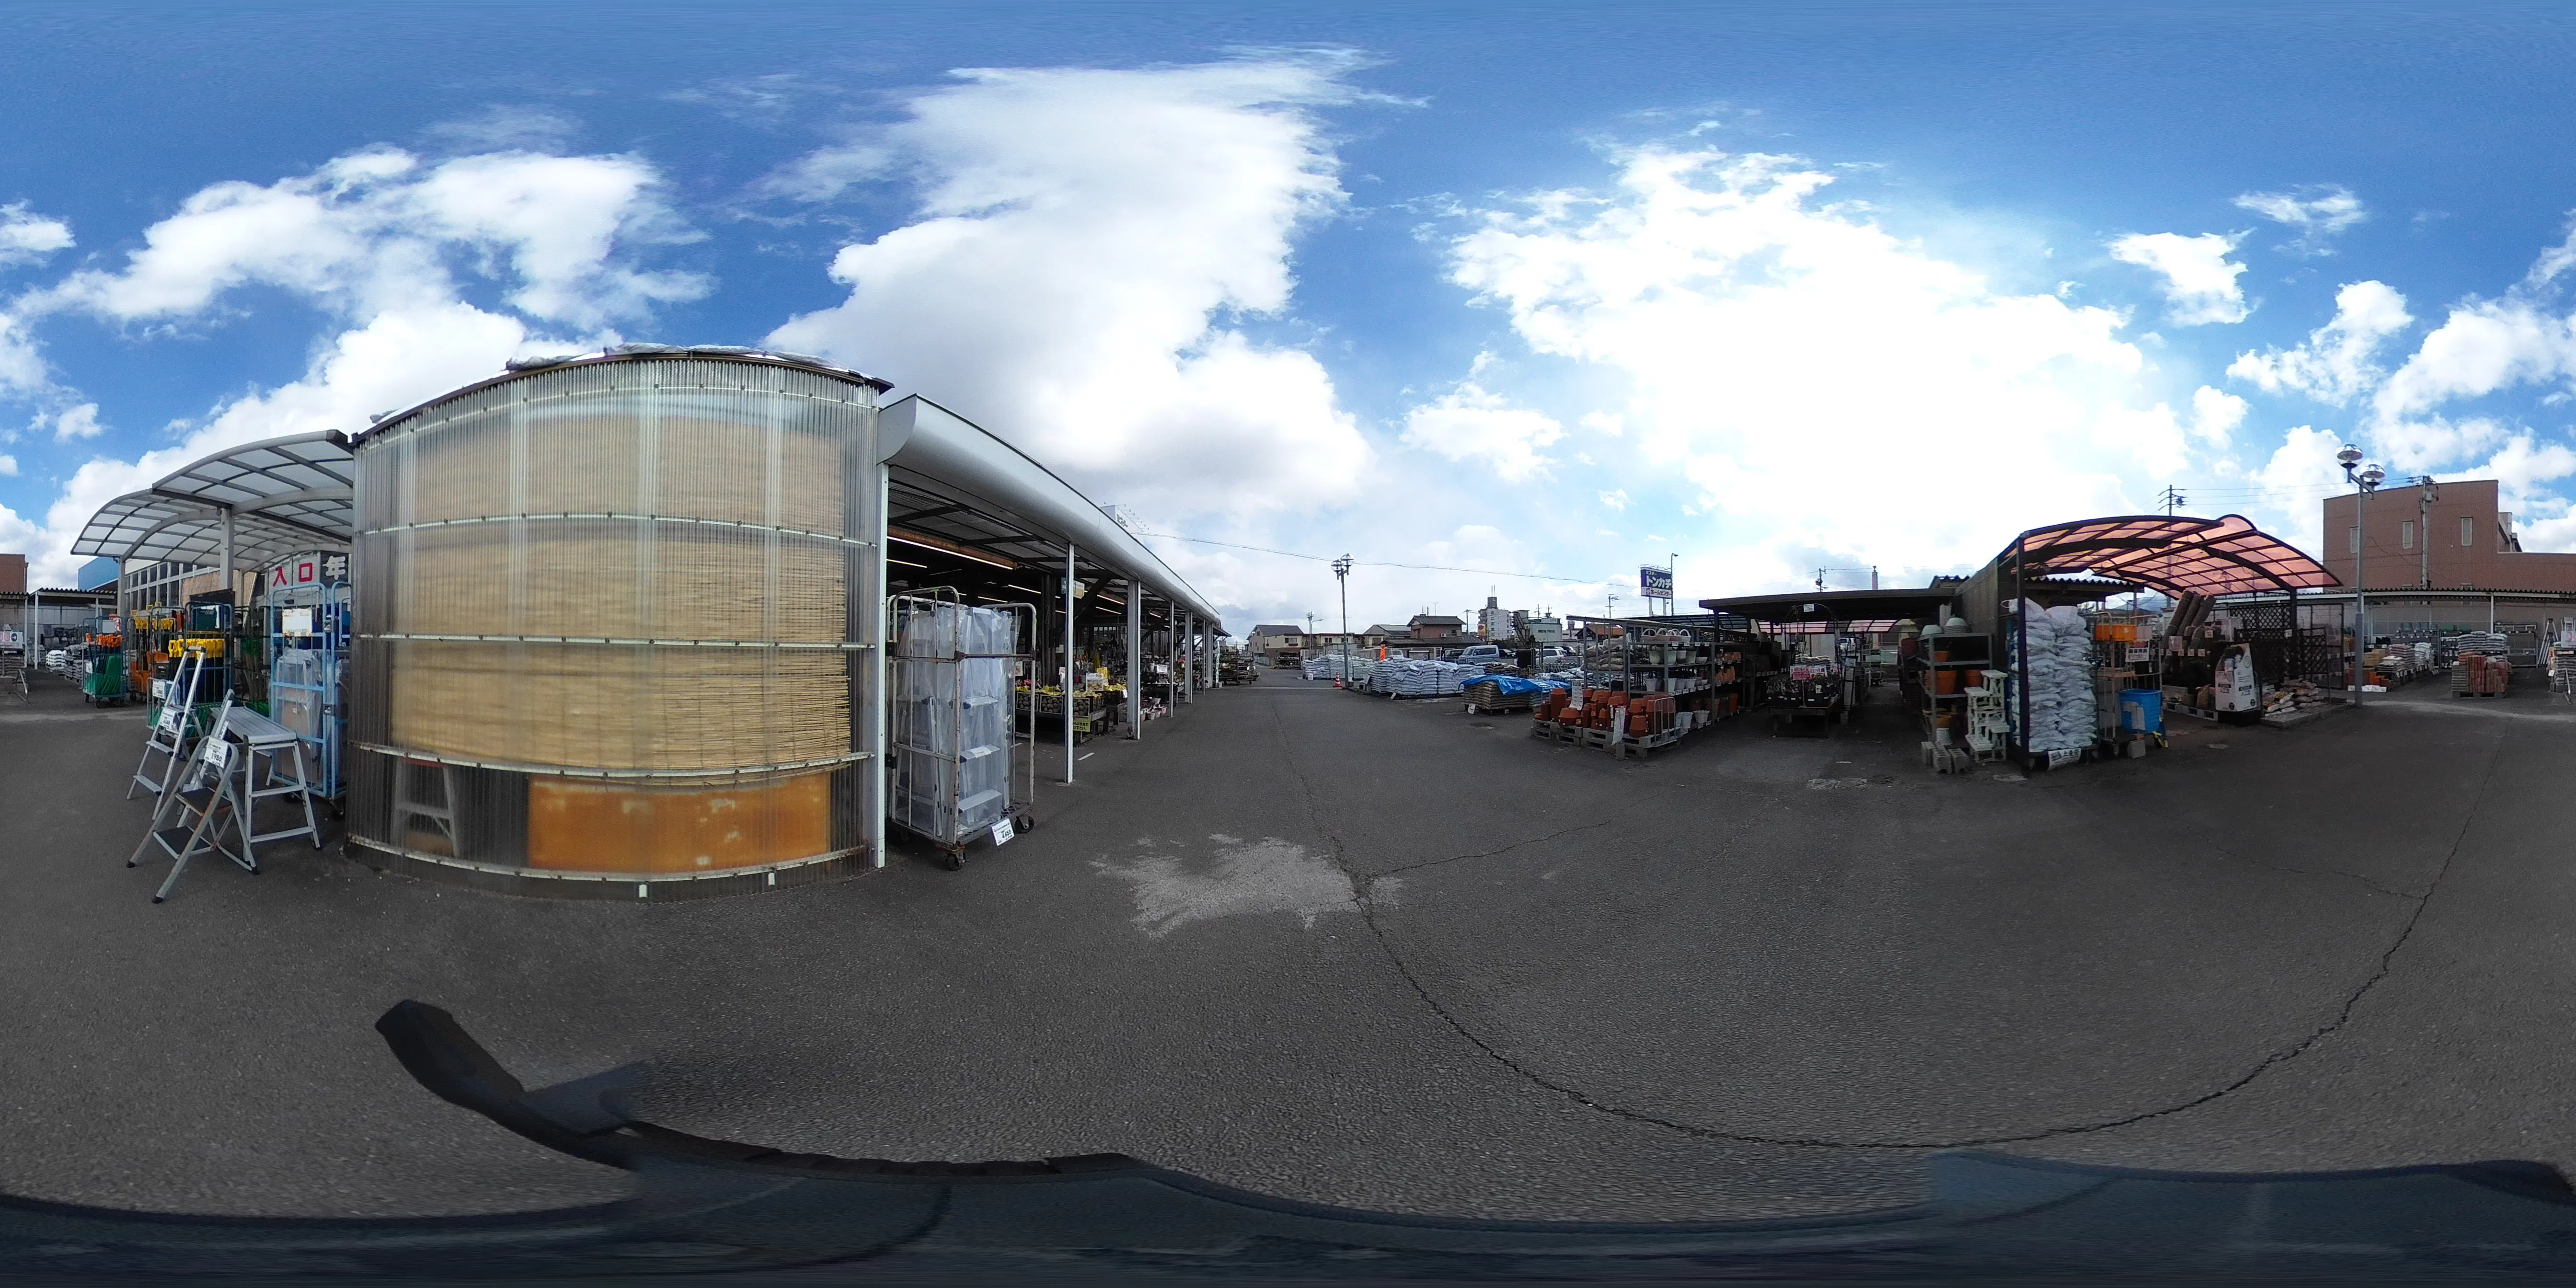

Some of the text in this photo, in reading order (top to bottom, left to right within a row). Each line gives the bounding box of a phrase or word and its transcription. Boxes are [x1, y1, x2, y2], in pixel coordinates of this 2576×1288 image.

[273, 563, 313, 587] 入口
[1646, 575, 1671, 588] トンカチ
